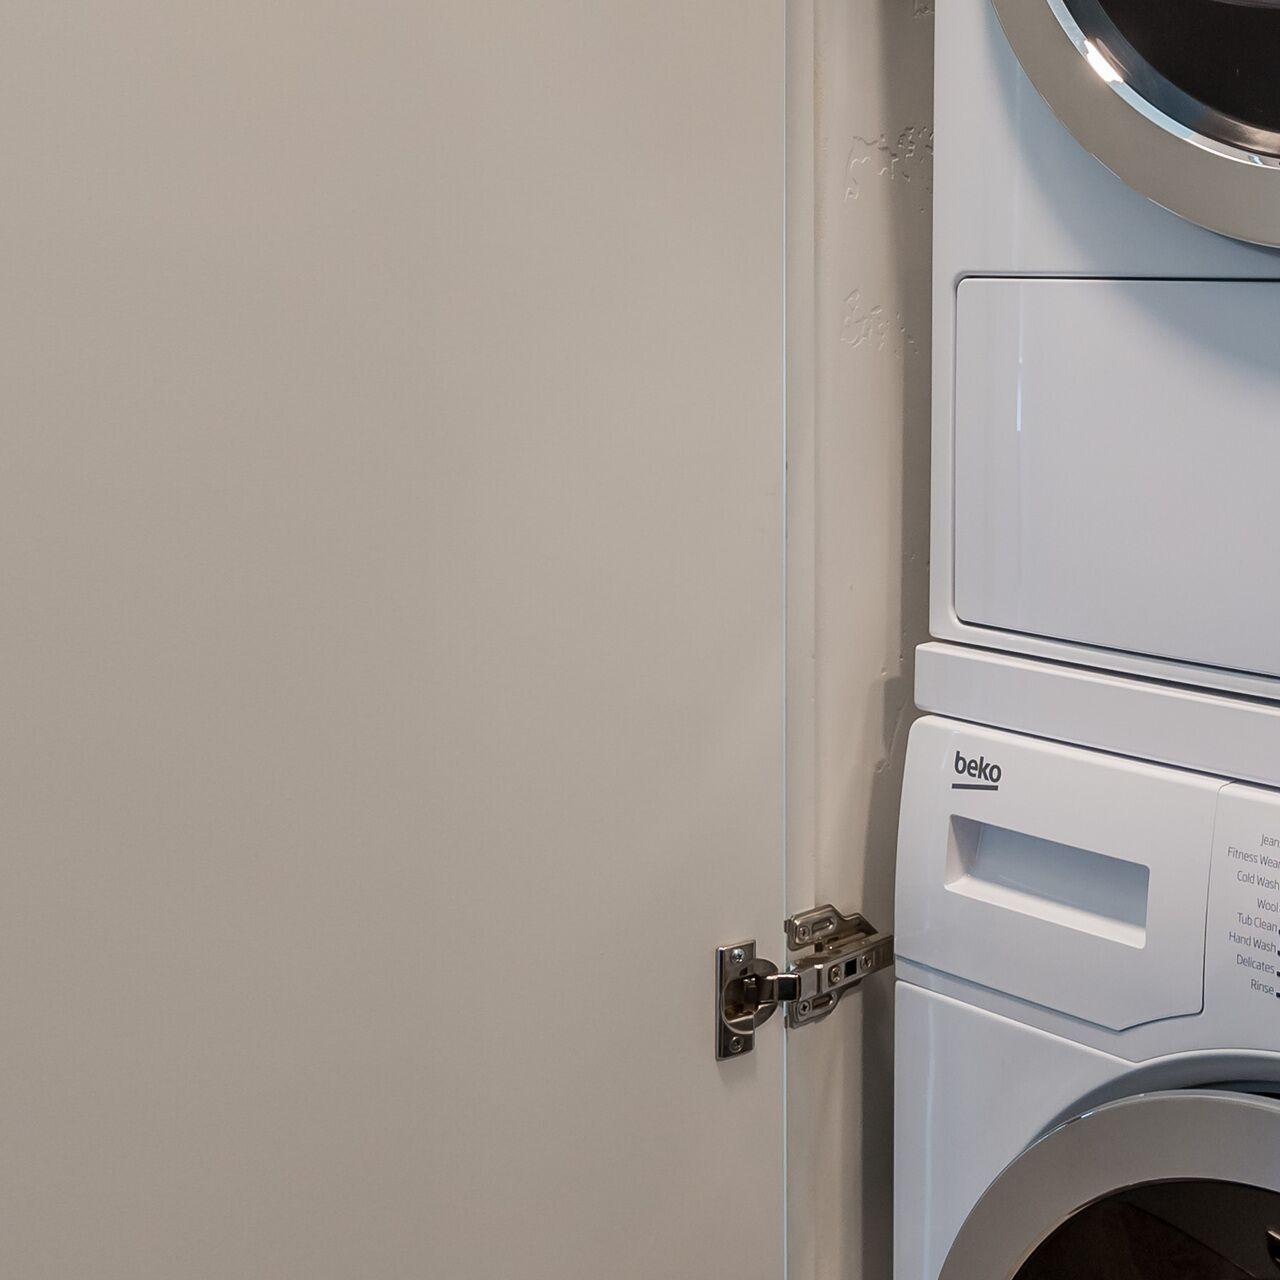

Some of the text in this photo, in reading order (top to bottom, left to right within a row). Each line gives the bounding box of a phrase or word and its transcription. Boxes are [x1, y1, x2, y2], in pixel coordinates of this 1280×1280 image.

[954, 751, 1002, 783] beko
[1228, 846, 1280, 868] Fitness Wear
[1237, 870, 1279, 890] Cold Wash
[1257, 898, 1278, 912] Wool
[1237, 912, 1278, 932] Tub Clean
[1228, 931, 1277, 952] Hand Wash
[1236, 954, 1274, 973] Delicates
[1250, 979, 1274, 995] Rinse
